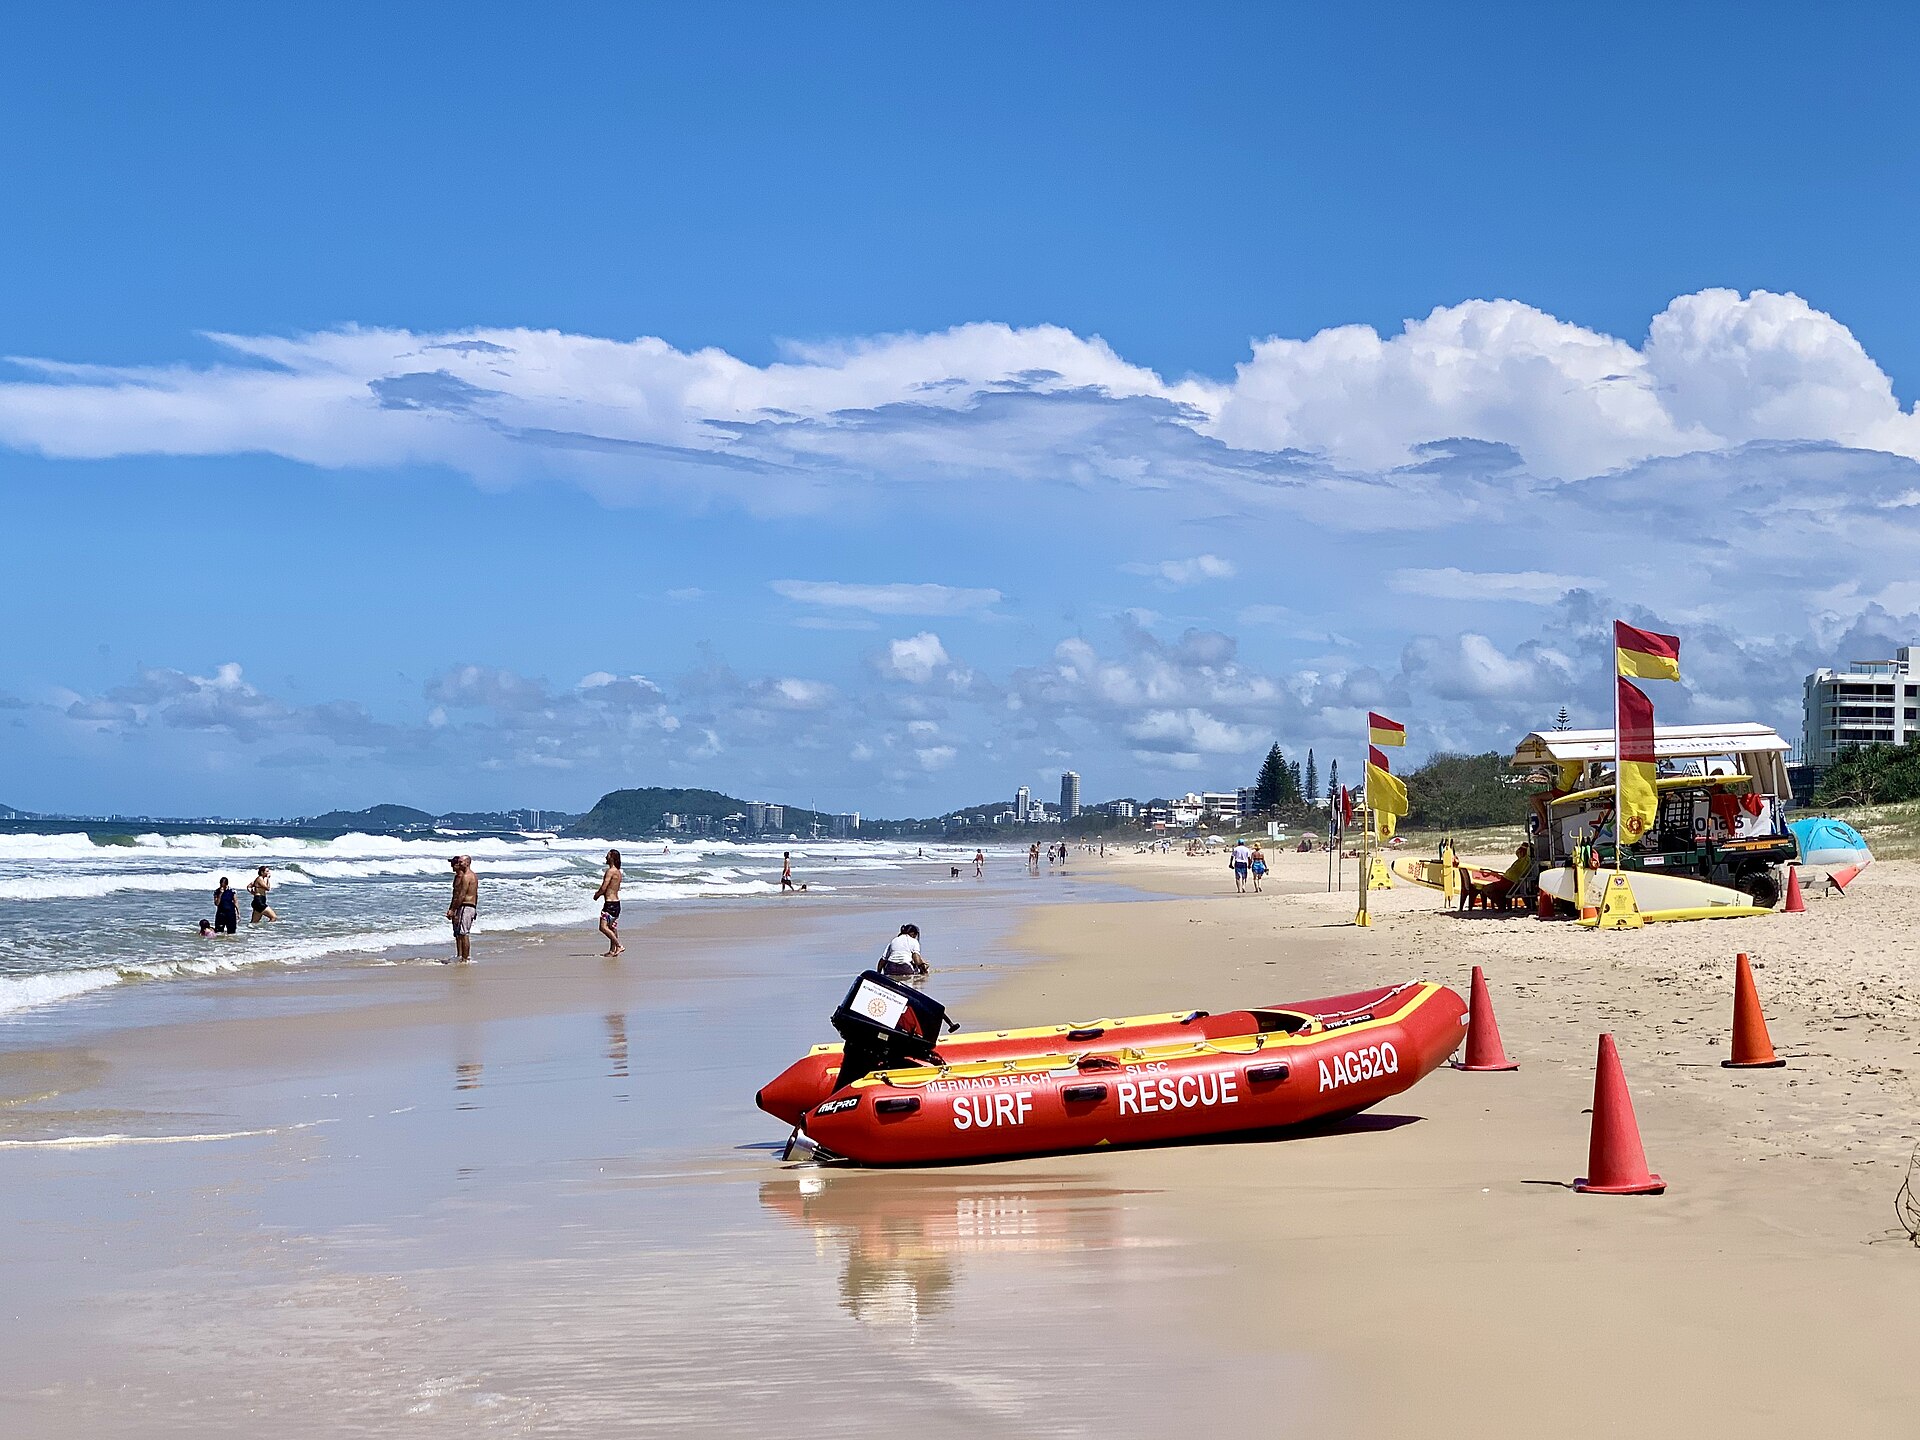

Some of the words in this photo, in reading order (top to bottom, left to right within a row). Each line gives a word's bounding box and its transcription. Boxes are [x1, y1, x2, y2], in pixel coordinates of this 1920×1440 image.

[926, 1077, 996, 1093] MERMAID
[998, 1072, 1052, 1088] BEACH
[1125, 1062, 1169, 1076] SLSC
[1318, 1041, 1399, 1093] AAG52Q
[953, 1091, 1033, 1130] SURF
[1117, 1071, 1239, 1116] RESCUE
